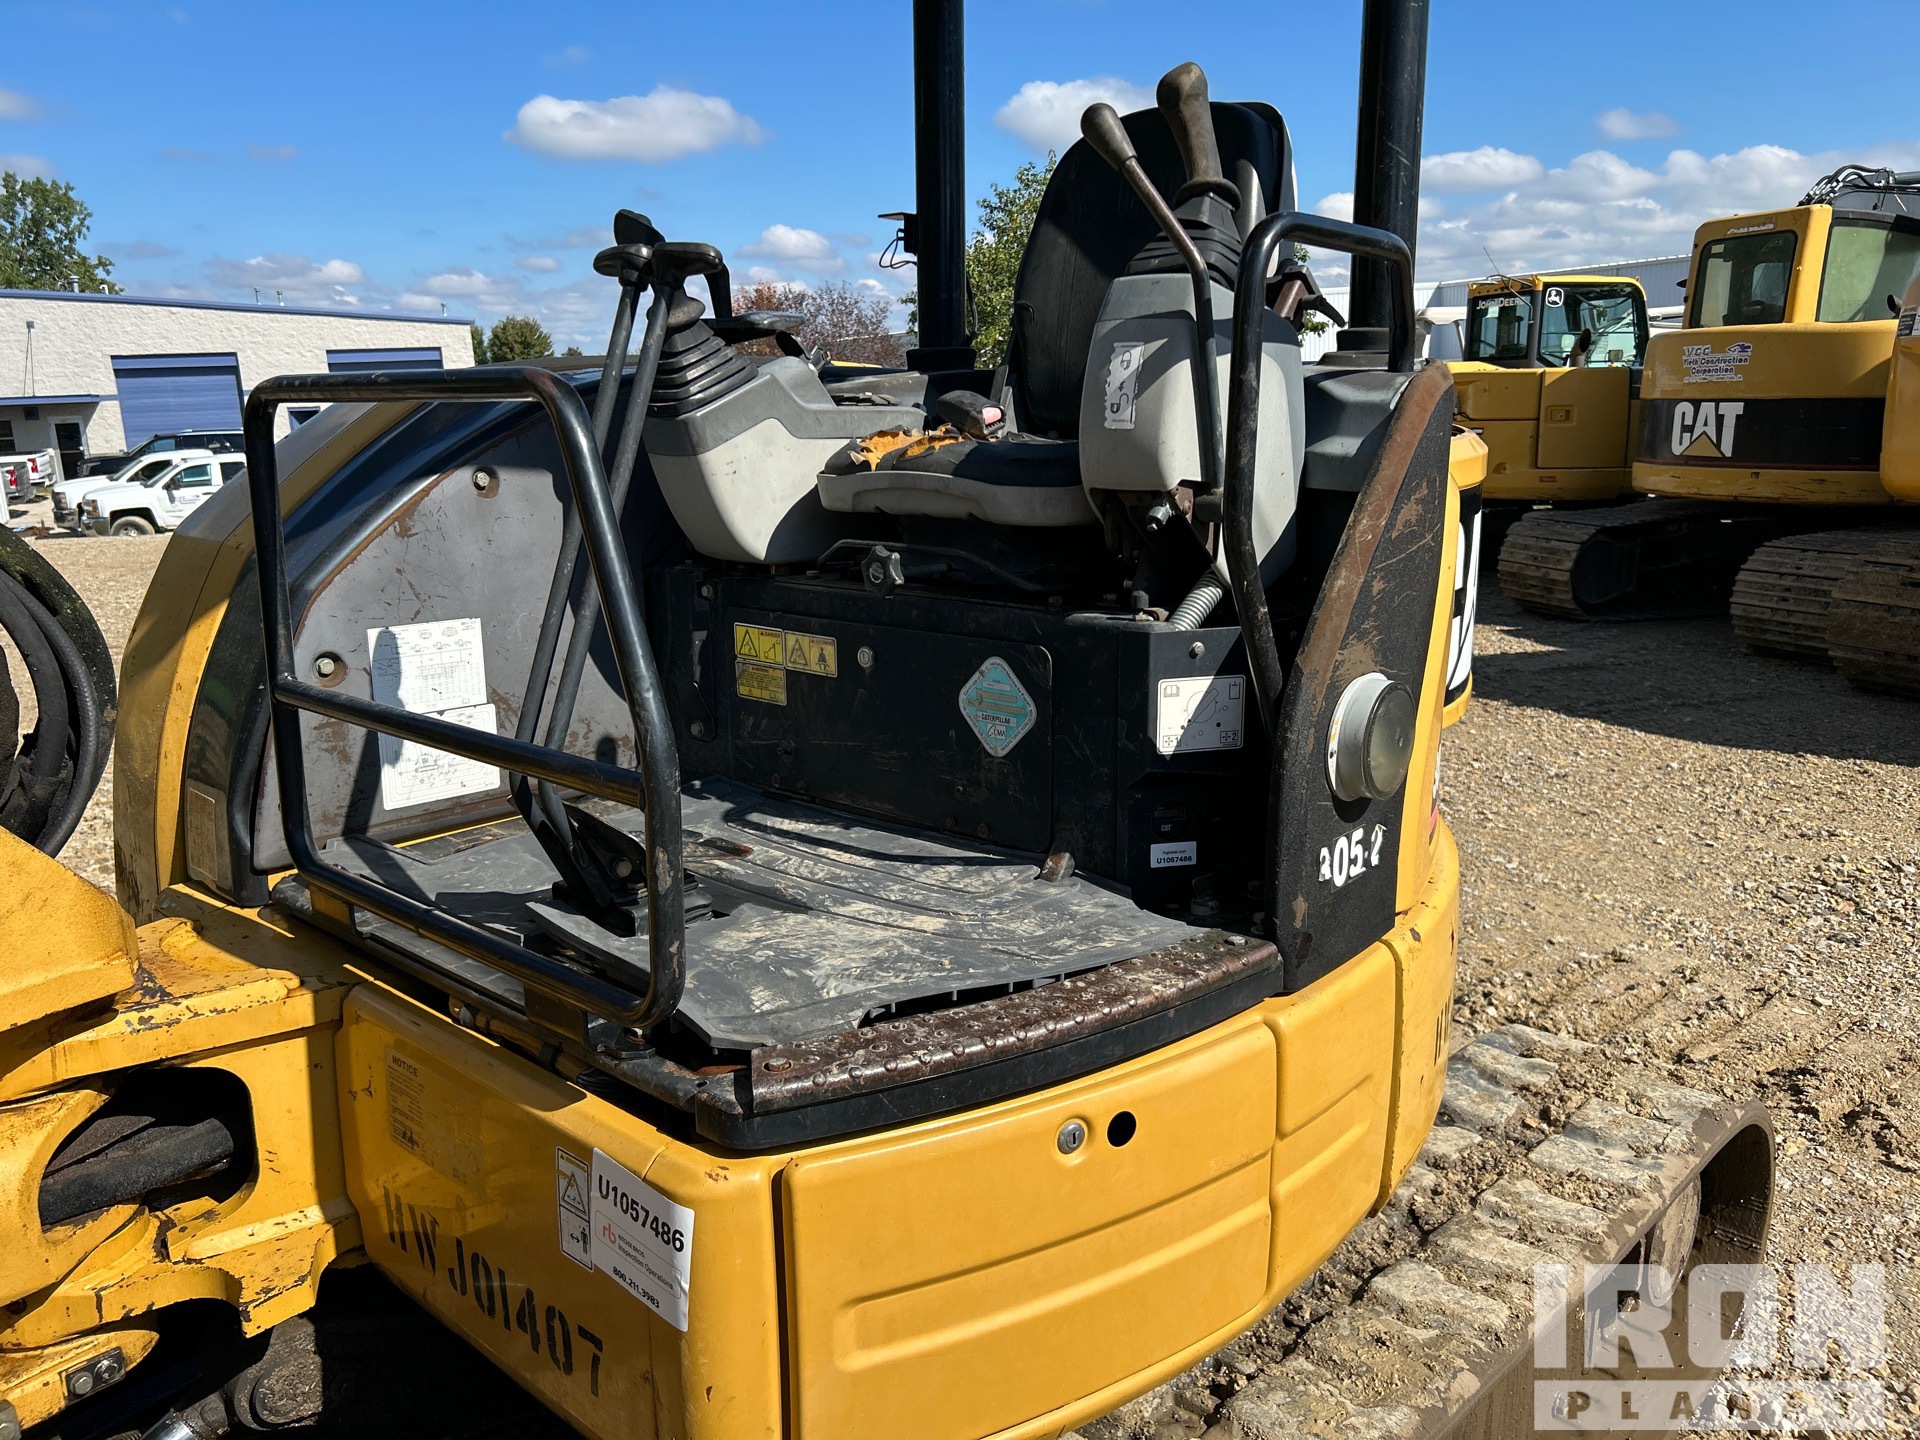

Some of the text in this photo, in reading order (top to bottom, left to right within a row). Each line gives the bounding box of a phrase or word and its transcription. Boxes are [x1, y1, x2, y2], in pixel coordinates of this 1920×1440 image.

[1476, 299, 1496, 310] JOHN
[1700, 354, 1749, 366] Construction
[1691, 365, 1734, 375] Corporation
[1671, 401, 1745, 458] CAT
[981, 713, 1011, 725] CATERPILLAR
[1231, 732, 1238, 741] 2
[1160, 824, 1172, 832] CAT
[1156, 855, 1193, 865] U1057486
[391, 1054, 419, 1078] NOTICE
[598, 1173, 685, 1253] U1057486
[602, 1223, 617, 1246] rb
[617, 1243, 674, 1291] Inspection Operations
[612, 1266, 660, 1310] 800.211.3983
